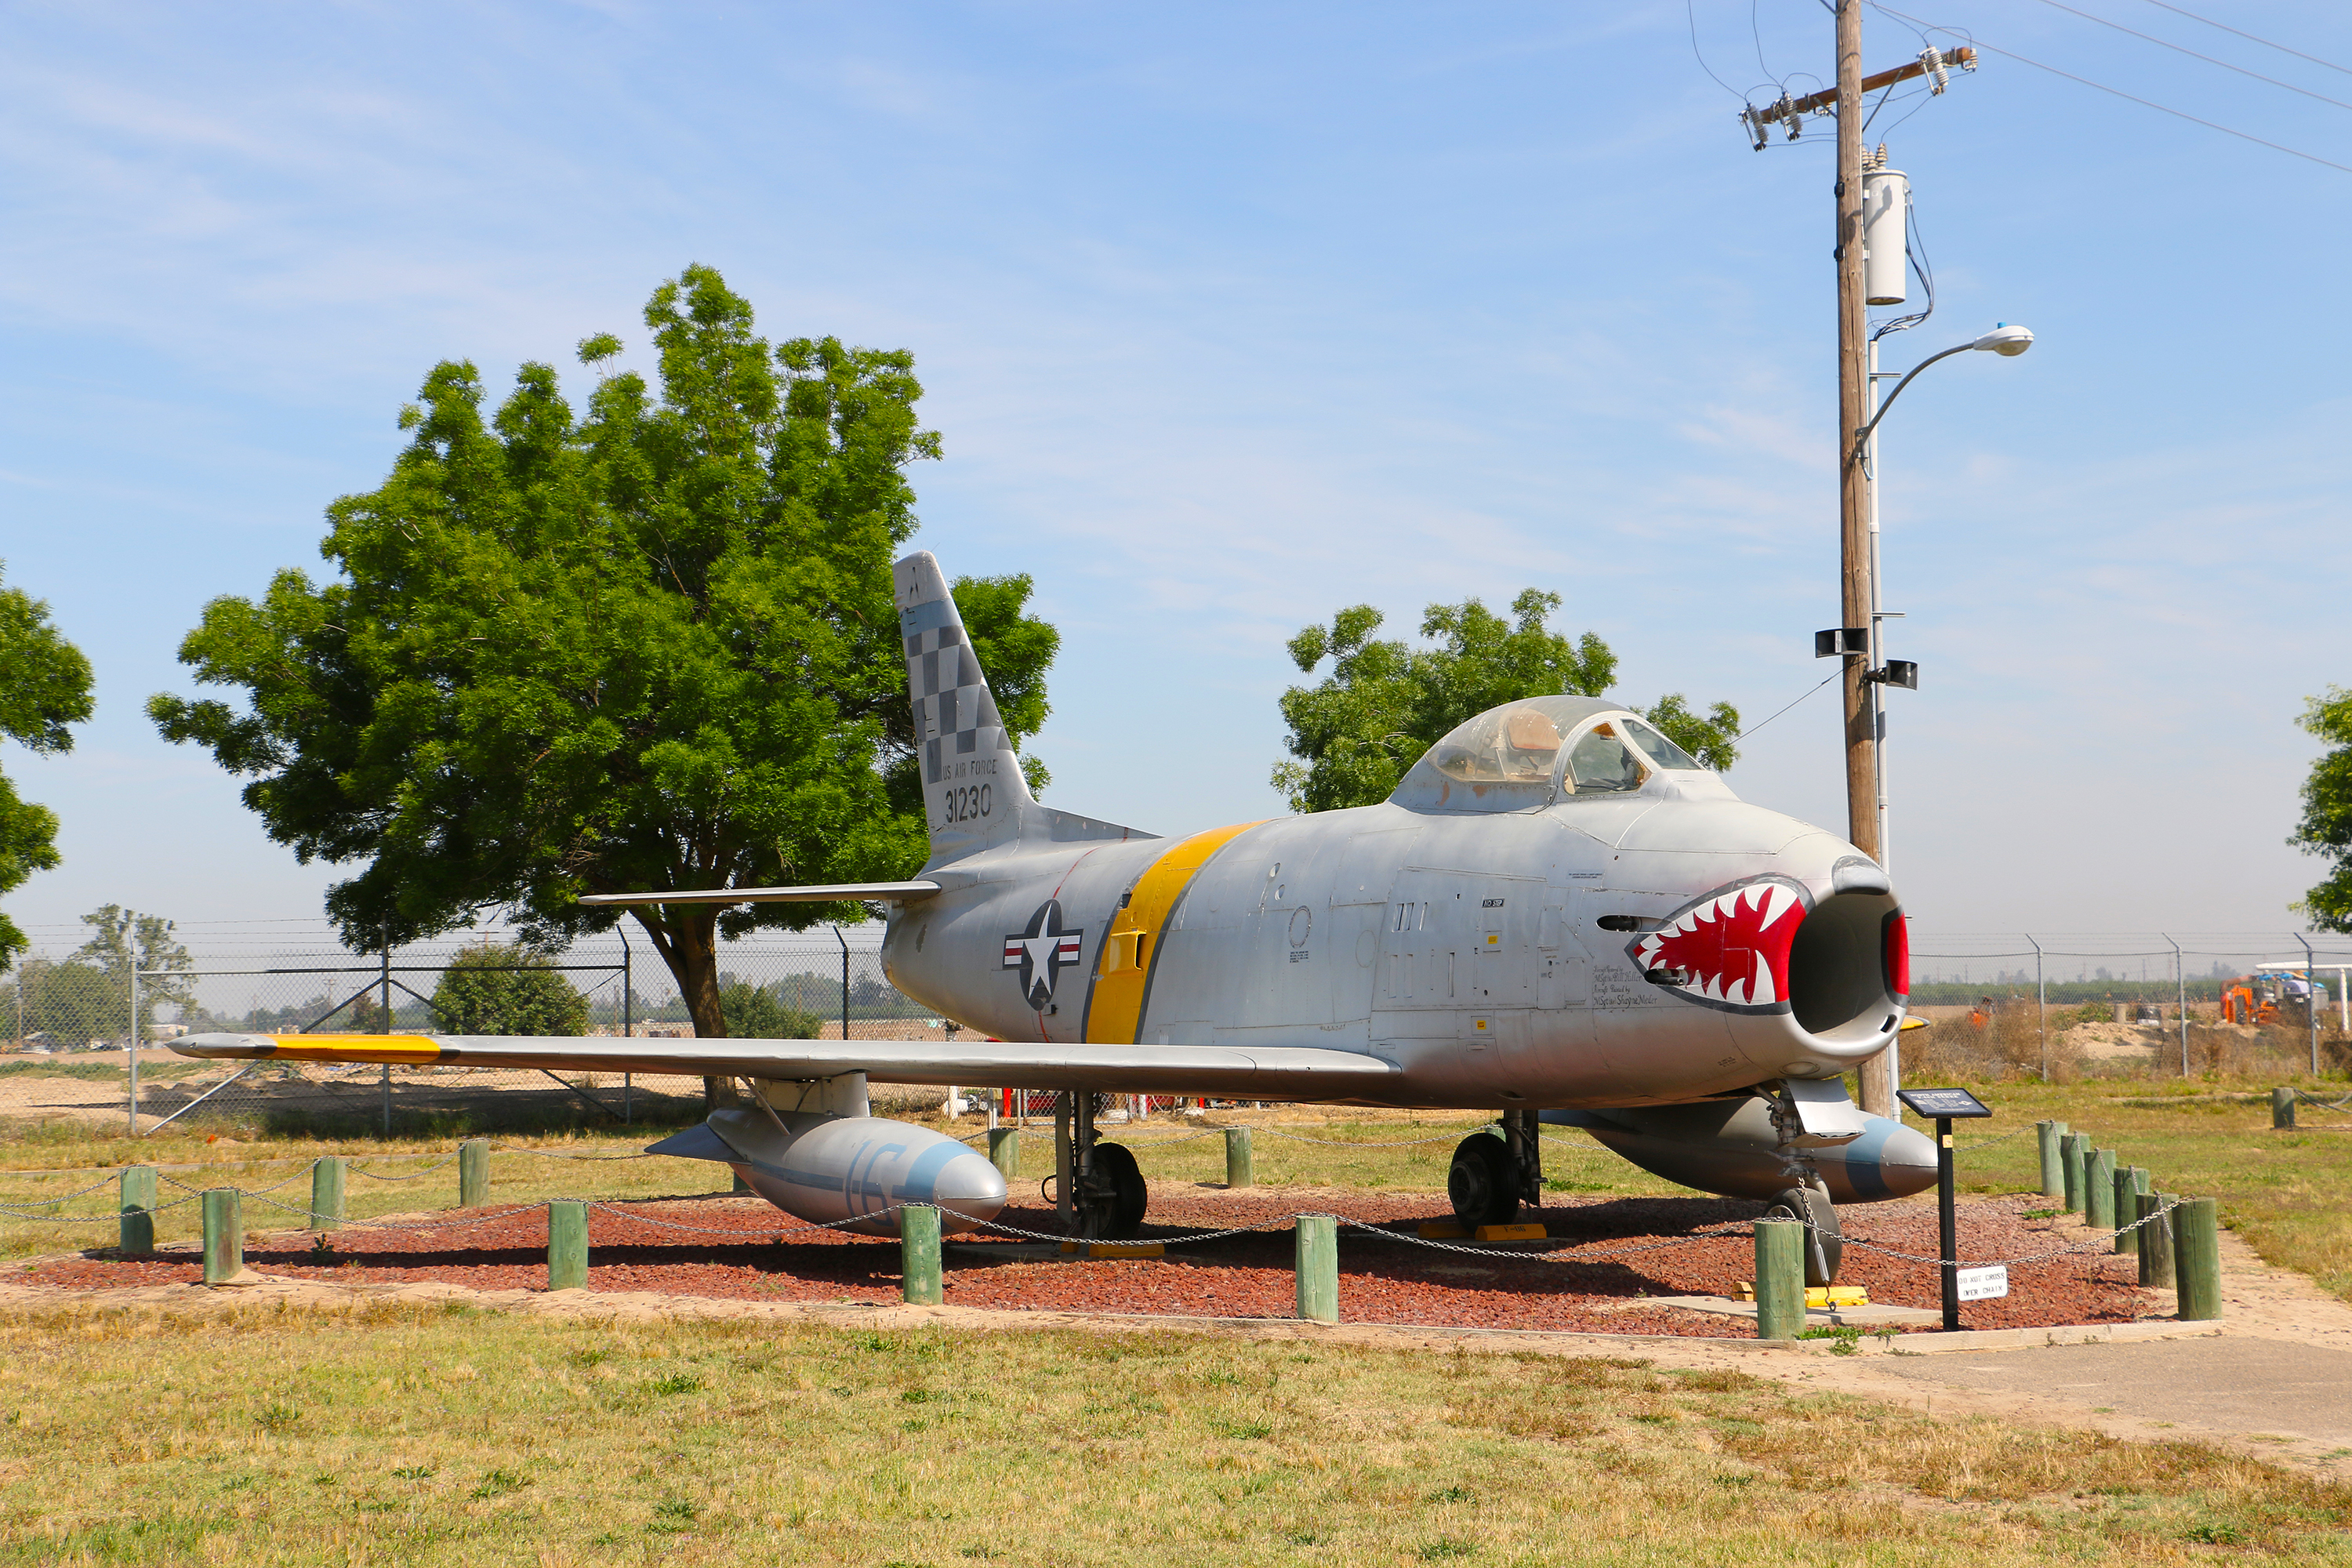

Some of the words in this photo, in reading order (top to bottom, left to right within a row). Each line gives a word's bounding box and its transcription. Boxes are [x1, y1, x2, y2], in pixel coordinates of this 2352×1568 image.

[942, 765, 952, 780] US
[955, 762, 966, 779] AIR
[971, 759, 998, 775] FORCE
[946, 783, 992, 823] 31230
[1617, 994, 1638, 1009] Shayne
[1985, 1272, 2005, 1281] CROSS
[1983, 1285, 2003, 1294] CHAIN
